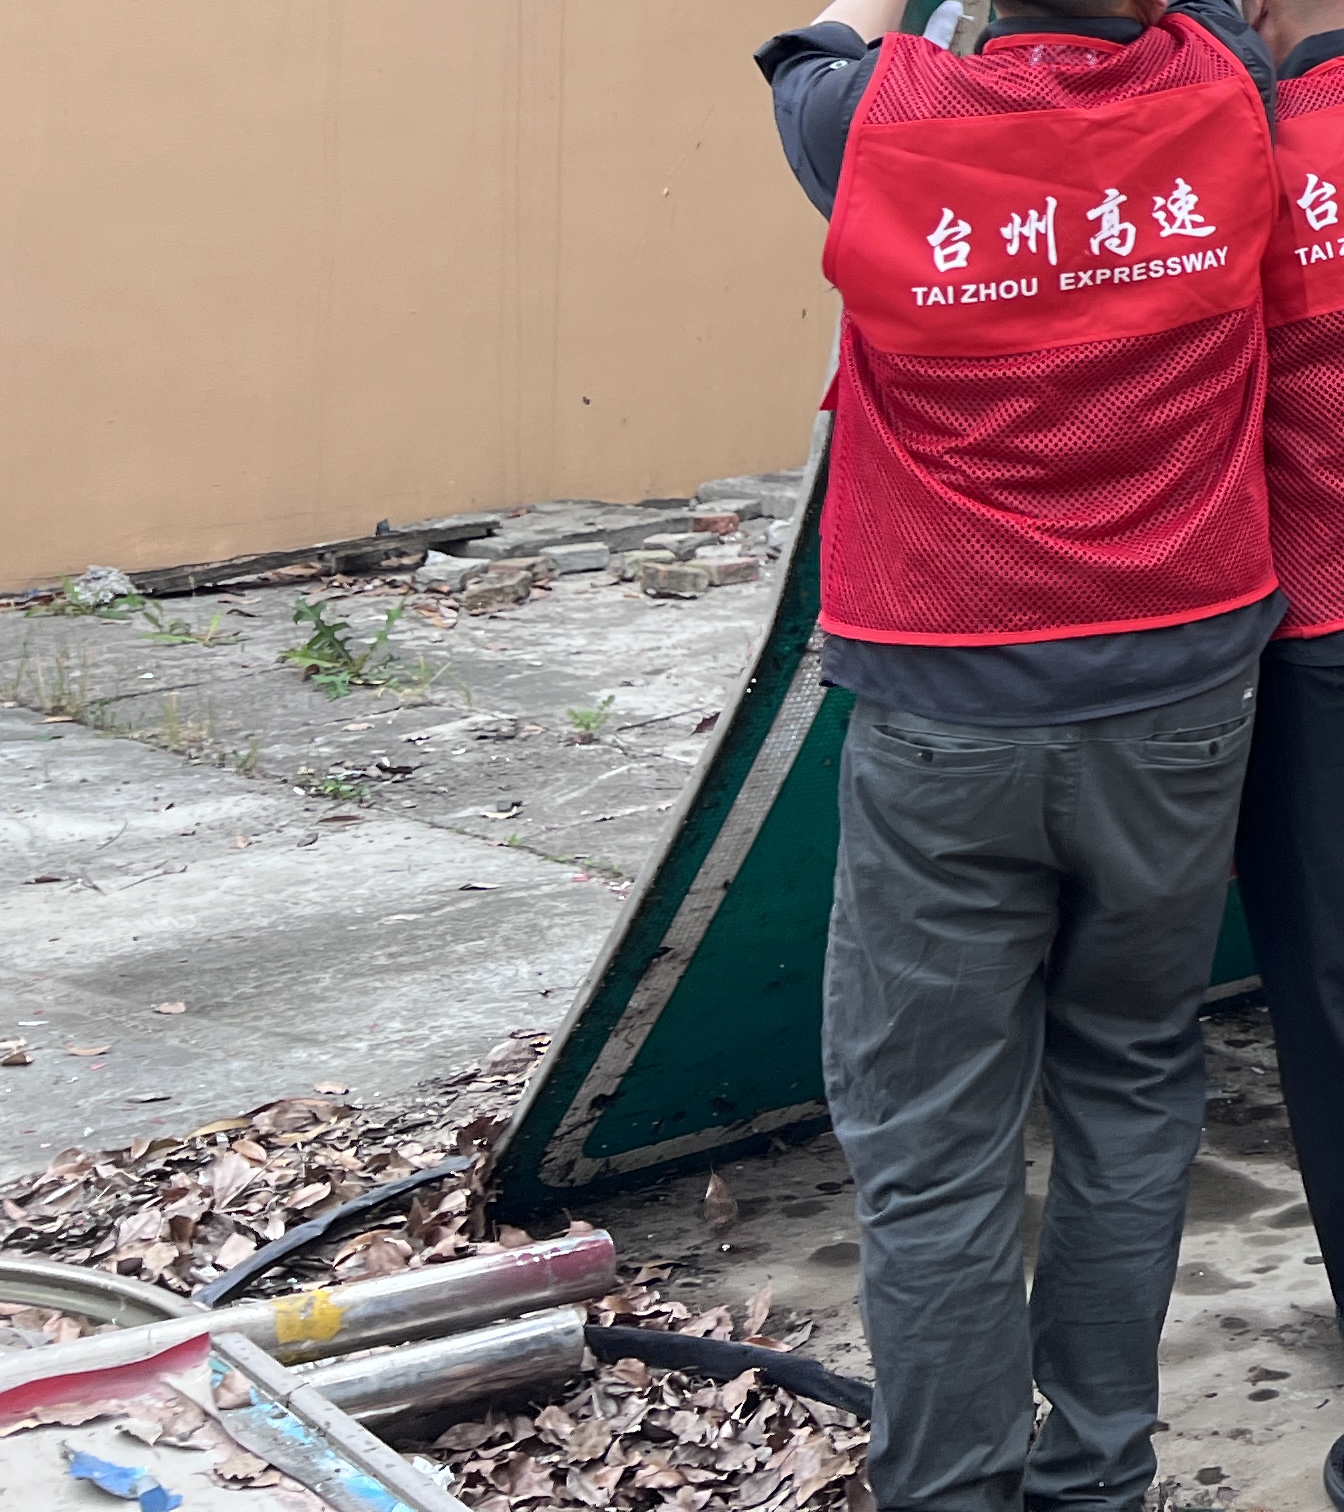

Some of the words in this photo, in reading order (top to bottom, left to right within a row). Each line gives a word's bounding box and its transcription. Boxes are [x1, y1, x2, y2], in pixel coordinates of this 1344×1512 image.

[926, 177, 1217, 272] 台州高速
[1059, 245, 1230, 291] EXPRESSWAY
